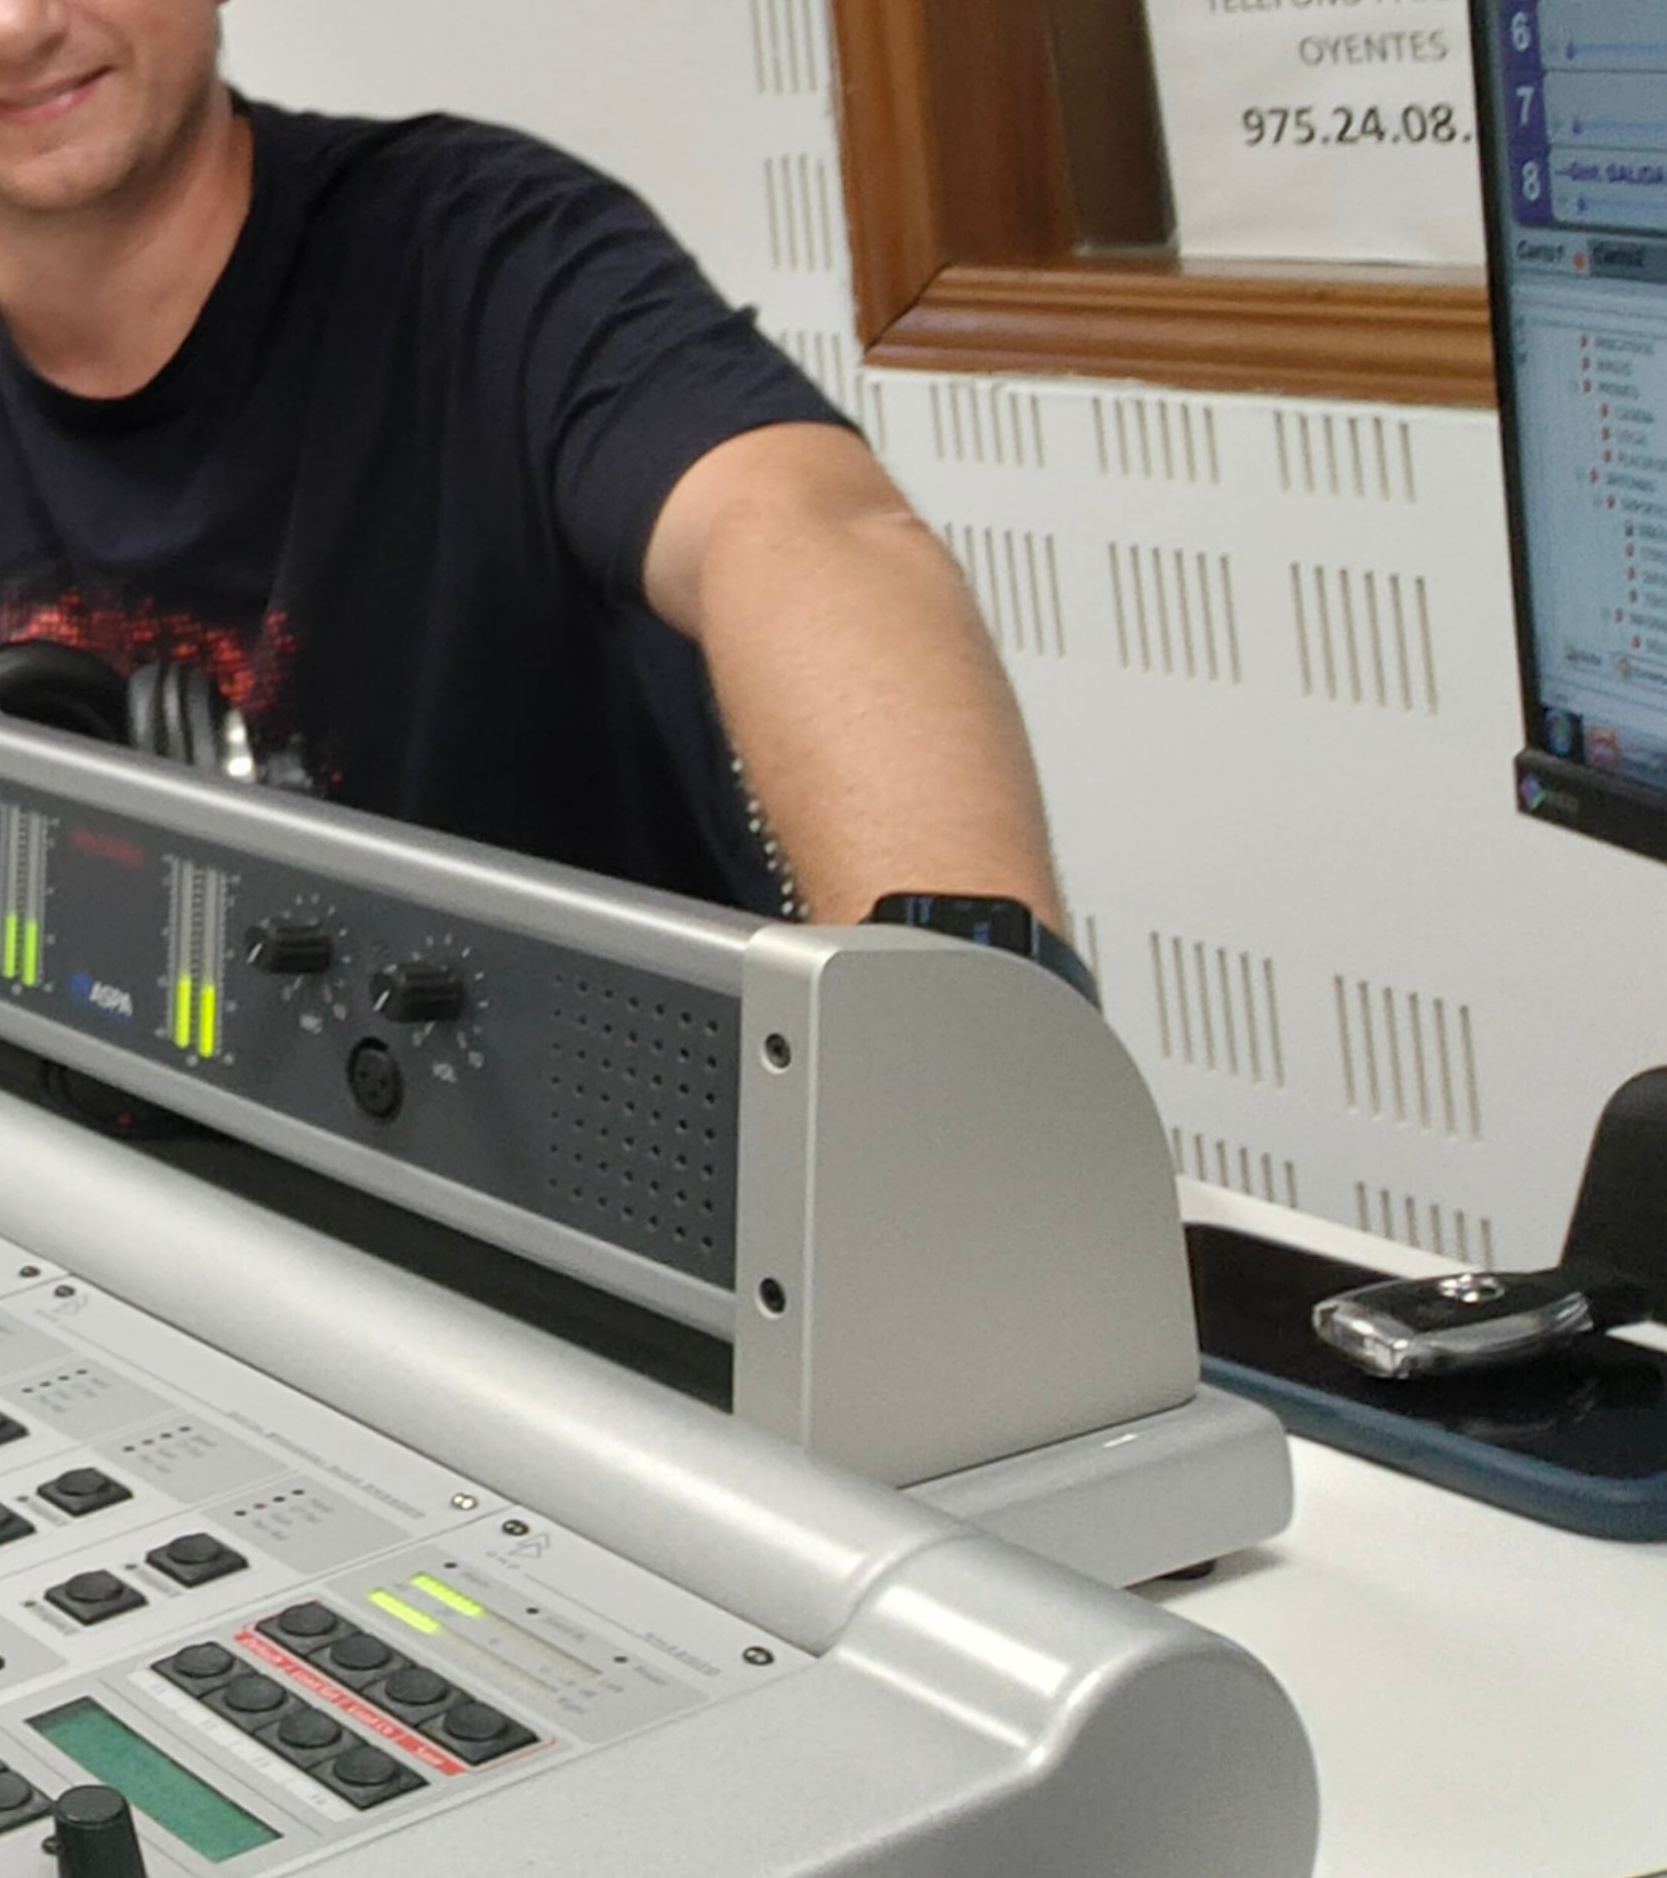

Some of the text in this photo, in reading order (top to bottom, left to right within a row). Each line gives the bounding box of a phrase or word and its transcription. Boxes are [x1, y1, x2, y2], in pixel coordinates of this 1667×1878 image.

[1298, 28, 1450, 68] OYENTES
[1510, 10, 1532, 53] 6
[1516, 85, 1536, 127] 7
[1521, 160, 1542, 202] 8
